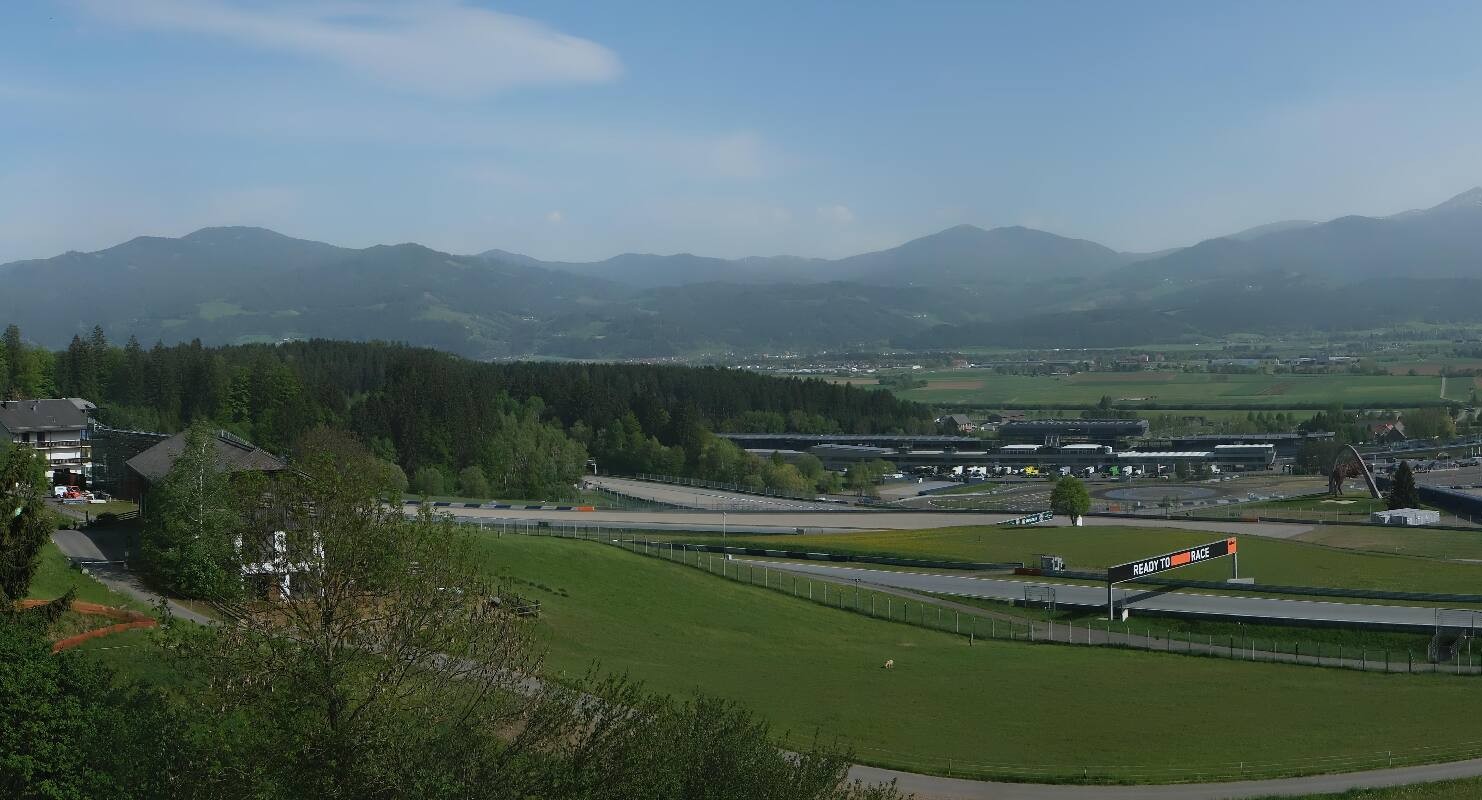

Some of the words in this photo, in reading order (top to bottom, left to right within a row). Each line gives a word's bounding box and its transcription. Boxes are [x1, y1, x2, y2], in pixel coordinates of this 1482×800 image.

[1133, 560, 1159, 576] READY
[1160, 557, 1171, 569] TO
[1191, 547, 1210, 562] RACE
